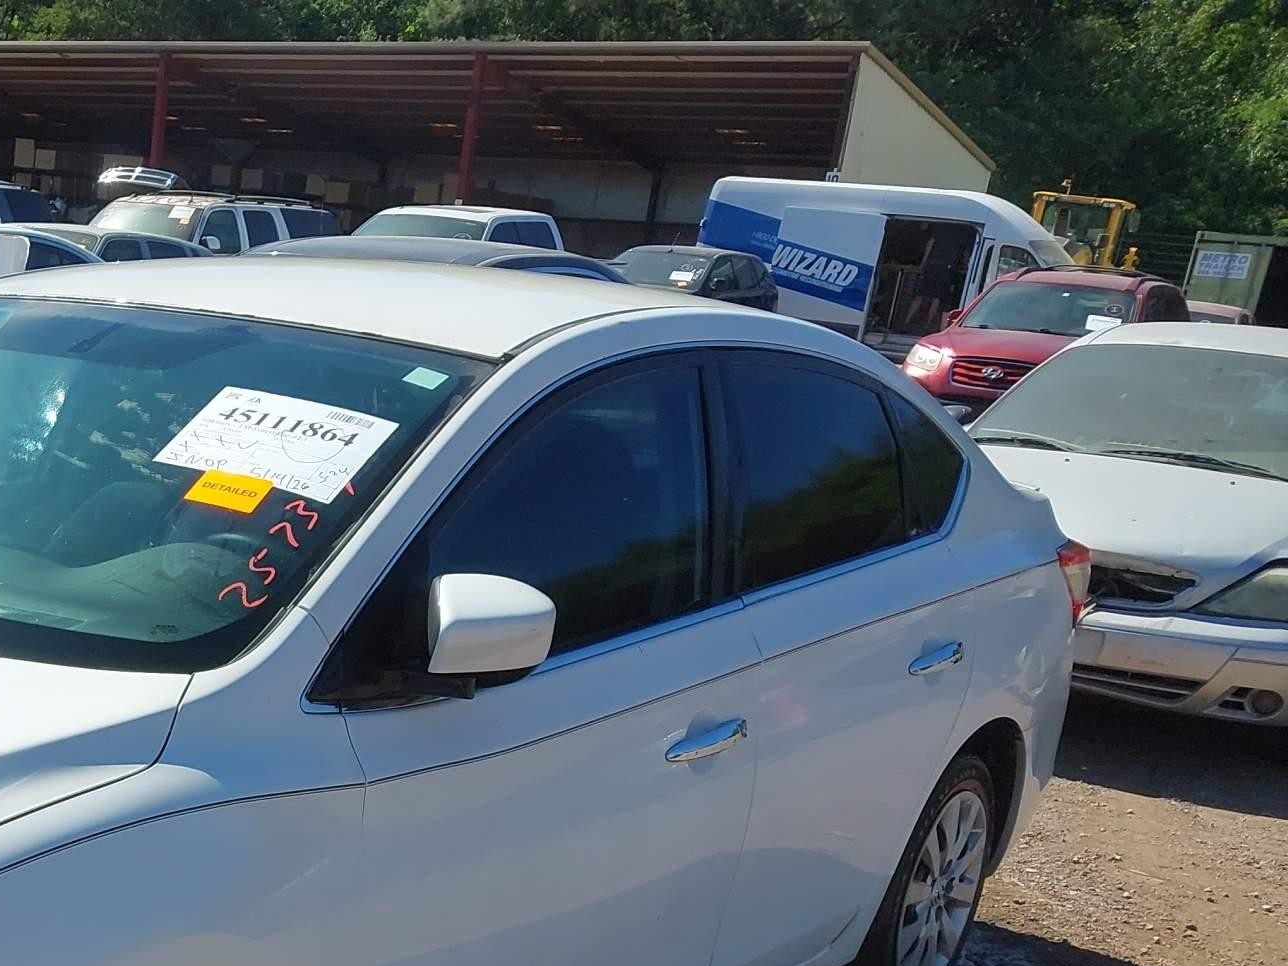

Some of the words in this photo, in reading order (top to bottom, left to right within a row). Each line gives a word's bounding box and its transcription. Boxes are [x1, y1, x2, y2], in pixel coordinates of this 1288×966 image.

[773, 244, 858, 287] WIZARD
[219, 407, 360, 447] 45111864
[202, 481, 258, 498] DETAILED
